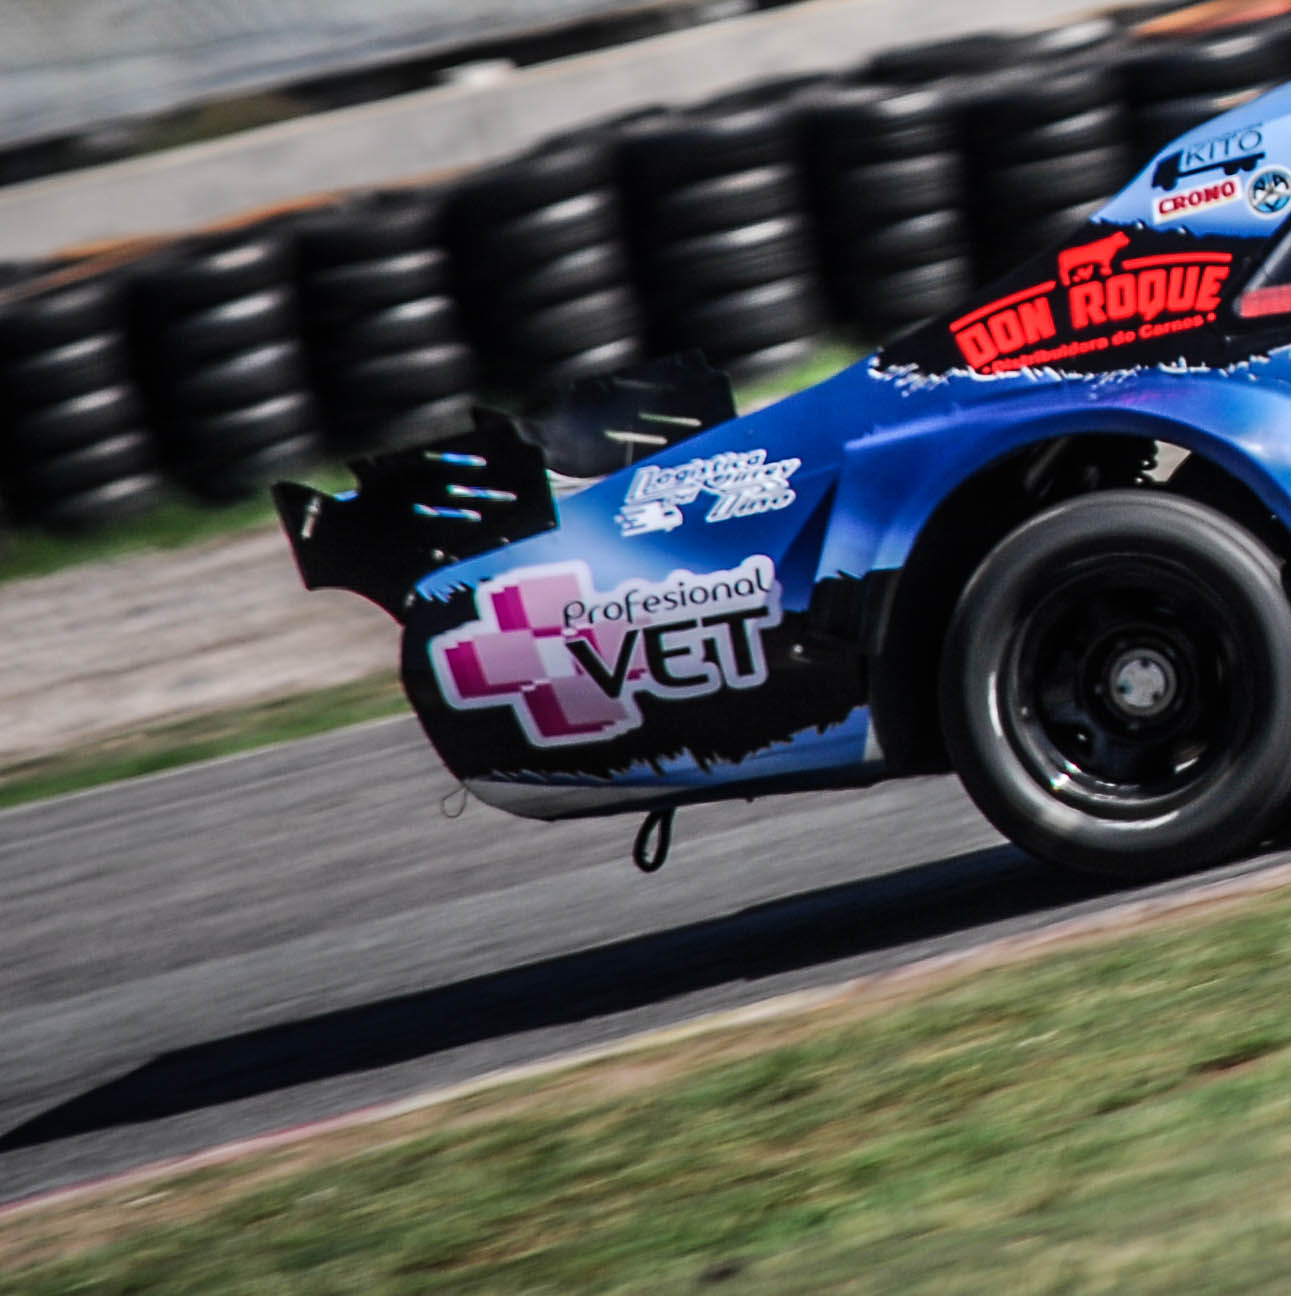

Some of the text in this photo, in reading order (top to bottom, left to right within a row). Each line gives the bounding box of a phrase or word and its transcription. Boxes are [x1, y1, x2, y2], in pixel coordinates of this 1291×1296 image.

[1158, 181, 1236, 215] CRONO
[955, 265, 1231, 370] DON ROQUE
[562, 566, 774, 629] Profesional
[566, 607, 769, 699] VET
